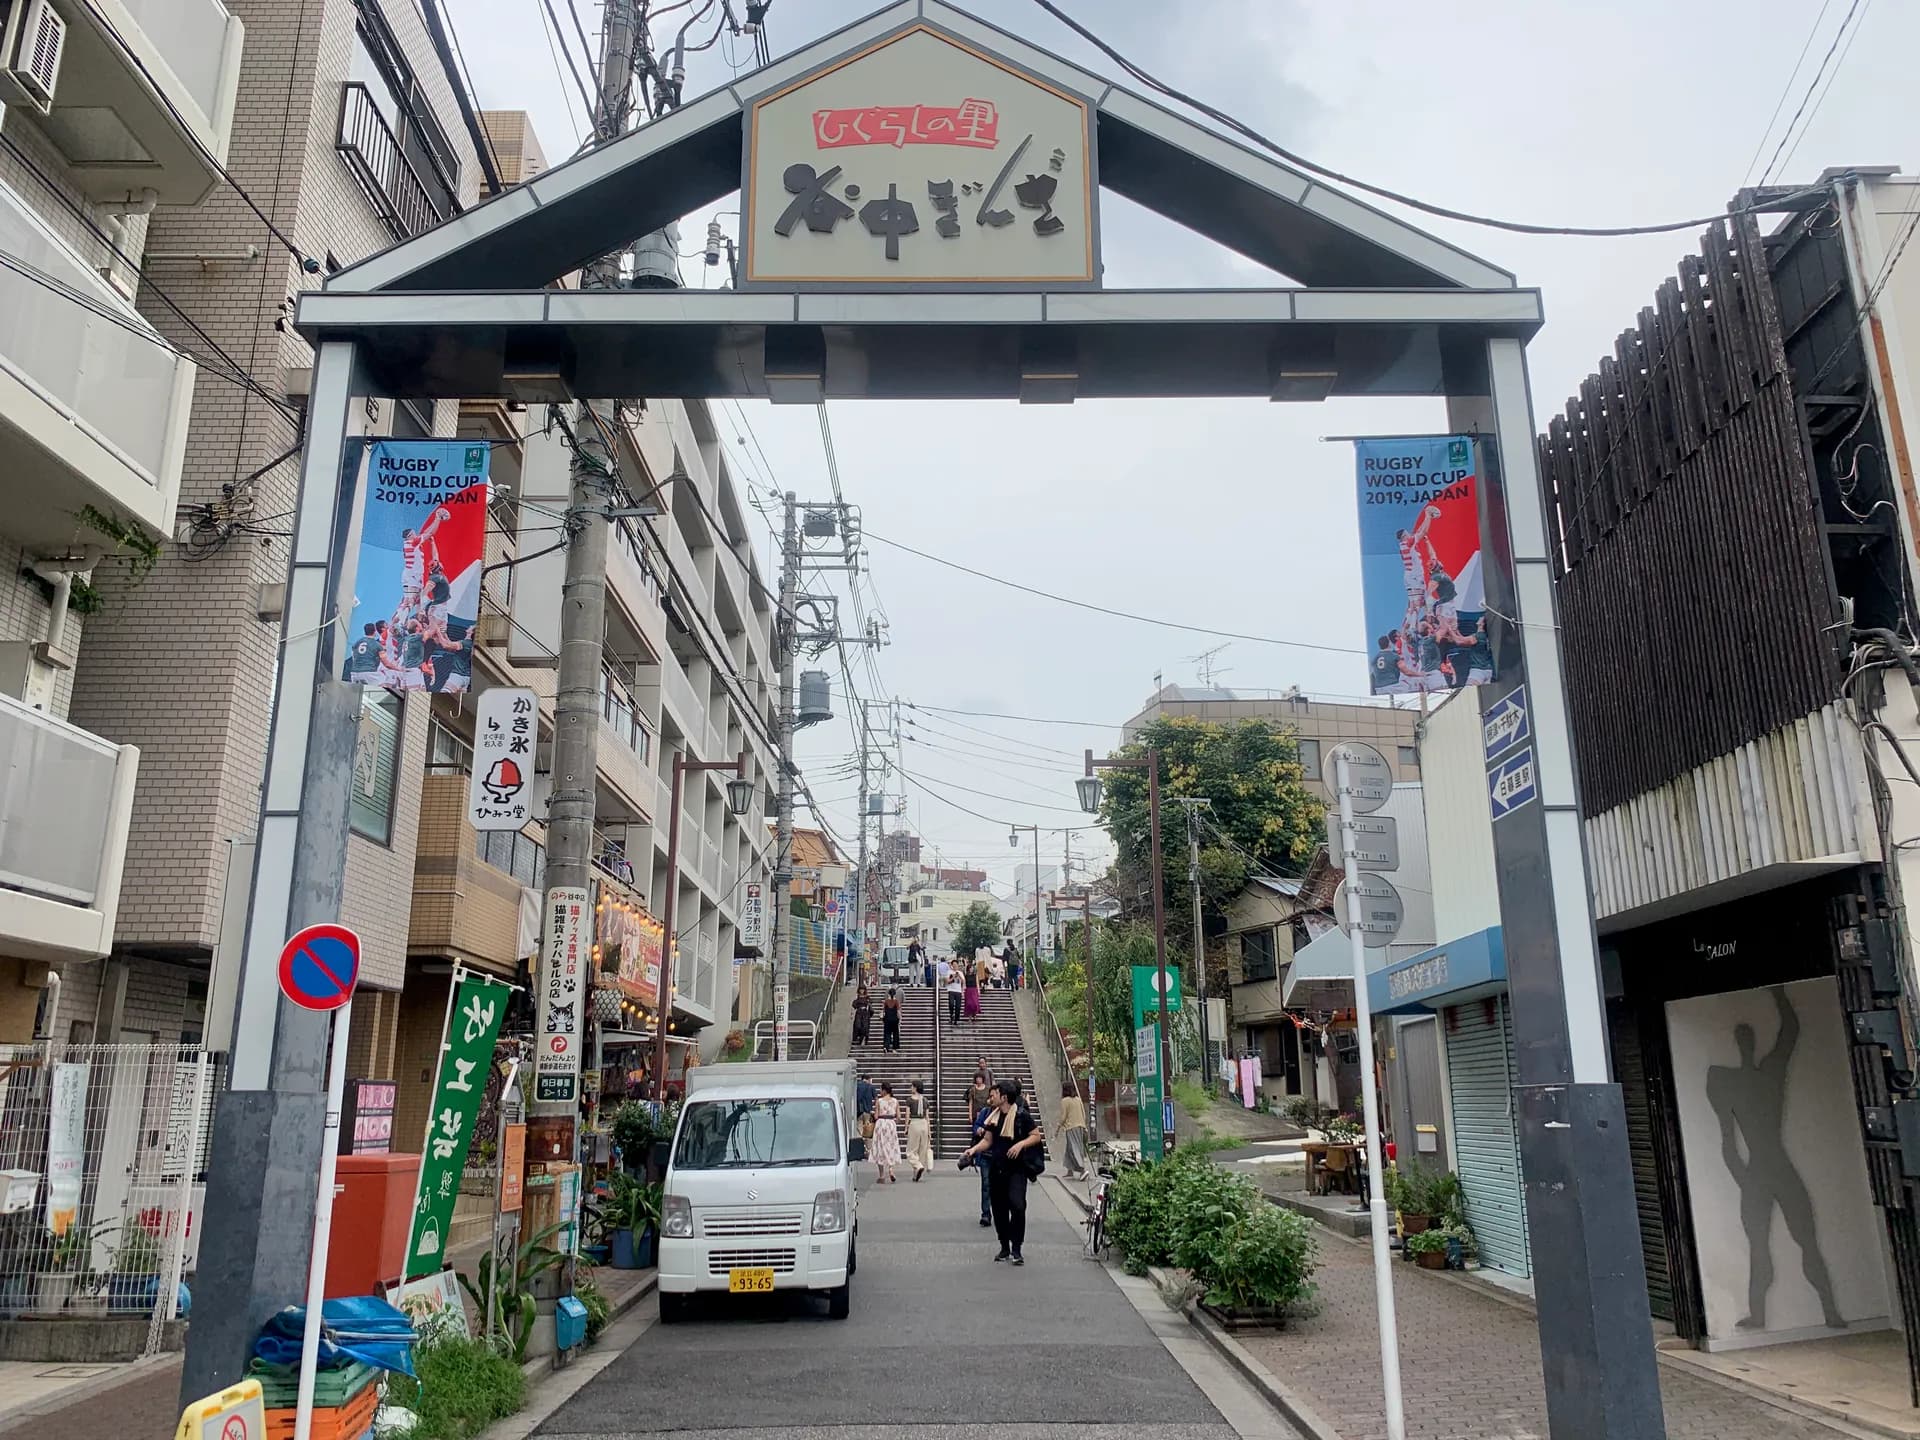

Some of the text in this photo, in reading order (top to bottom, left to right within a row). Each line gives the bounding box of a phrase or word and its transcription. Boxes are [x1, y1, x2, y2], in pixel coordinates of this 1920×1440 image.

[817, 99, 998, 146] ひぐらしの里
[774, 134, 1067, 261] 谷中ぎんざ
[378, 457, 439, 472] RUGBY
[1364, 456, 1423, 471] RUGBY
[378, 472, 480, 489] WORLD CUP
[1366, 469, 1467, 488] WORLD CUP
[375, 488, 478, 507] 2019, JAPAN
[1366, 485, 1469, 506] 2019, JAPAN
[358, 642, 368, 655] 6
[1377, 656, 1385, 669] 6
[509, 696, 532, 753] かき氷
[475, 804, 525, 819] ひみつ堂
[745, 899, 753, 932] クリニック
[1707, 940, 1737, 960] SALON
[739, 1278, 771, 1290] 93-65
